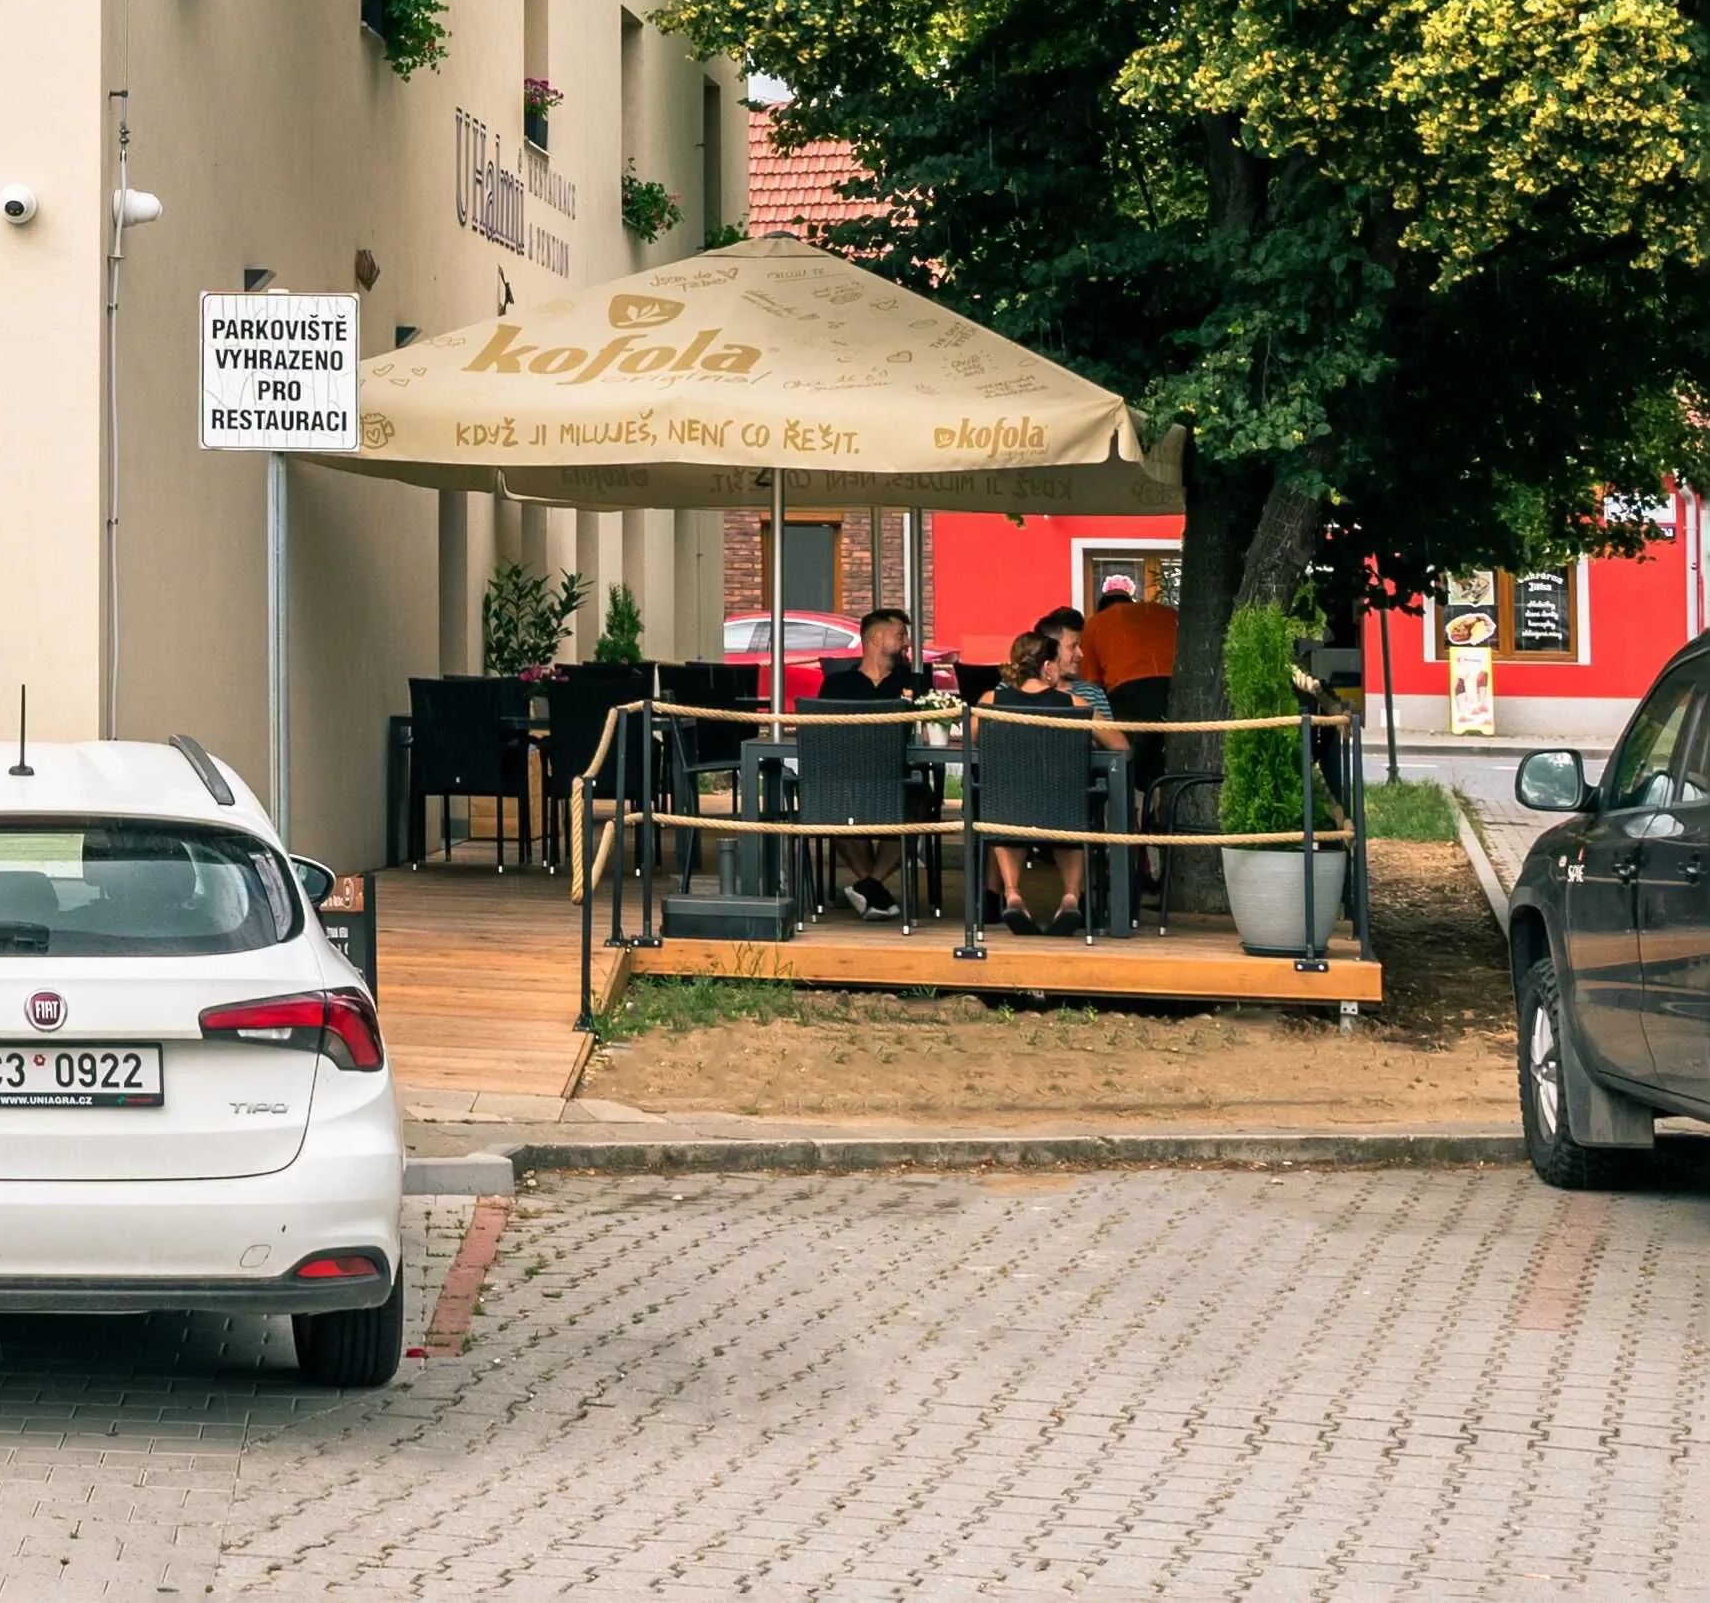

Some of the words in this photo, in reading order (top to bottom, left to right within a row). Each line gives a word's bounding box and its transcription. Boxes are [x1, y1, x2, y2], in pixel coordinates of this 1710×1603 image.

[211, 314, 348, 342] PARKOVIŠTĚ
[215, 349, 344, 371] VYHRAZENO
[460, 323, 763, 386] kofola
[258, 380, 302, 402] PRO
[211, 409, 348, 432] RESTAURACI
[455, 416, 518, 447] KDYŽ
[528, 424, 547, 446] JI
[559, 408, 658, 447] MILUJEŠ,
[668, 418, 734, 448] NENÍ
[740, 422, 770, 447] CO
[783, 417, 861, 454] ŘEŠIT.
[956, 416, 1046, 458] kofola
[34, 1000, 59, 1020] FIAT
[55, 1052, 144, 1089] 0922
[0, 1095, 93, 1106] WWW.UNIAGRA.CZ
[229, 1102, 289, 1115] TIPO
